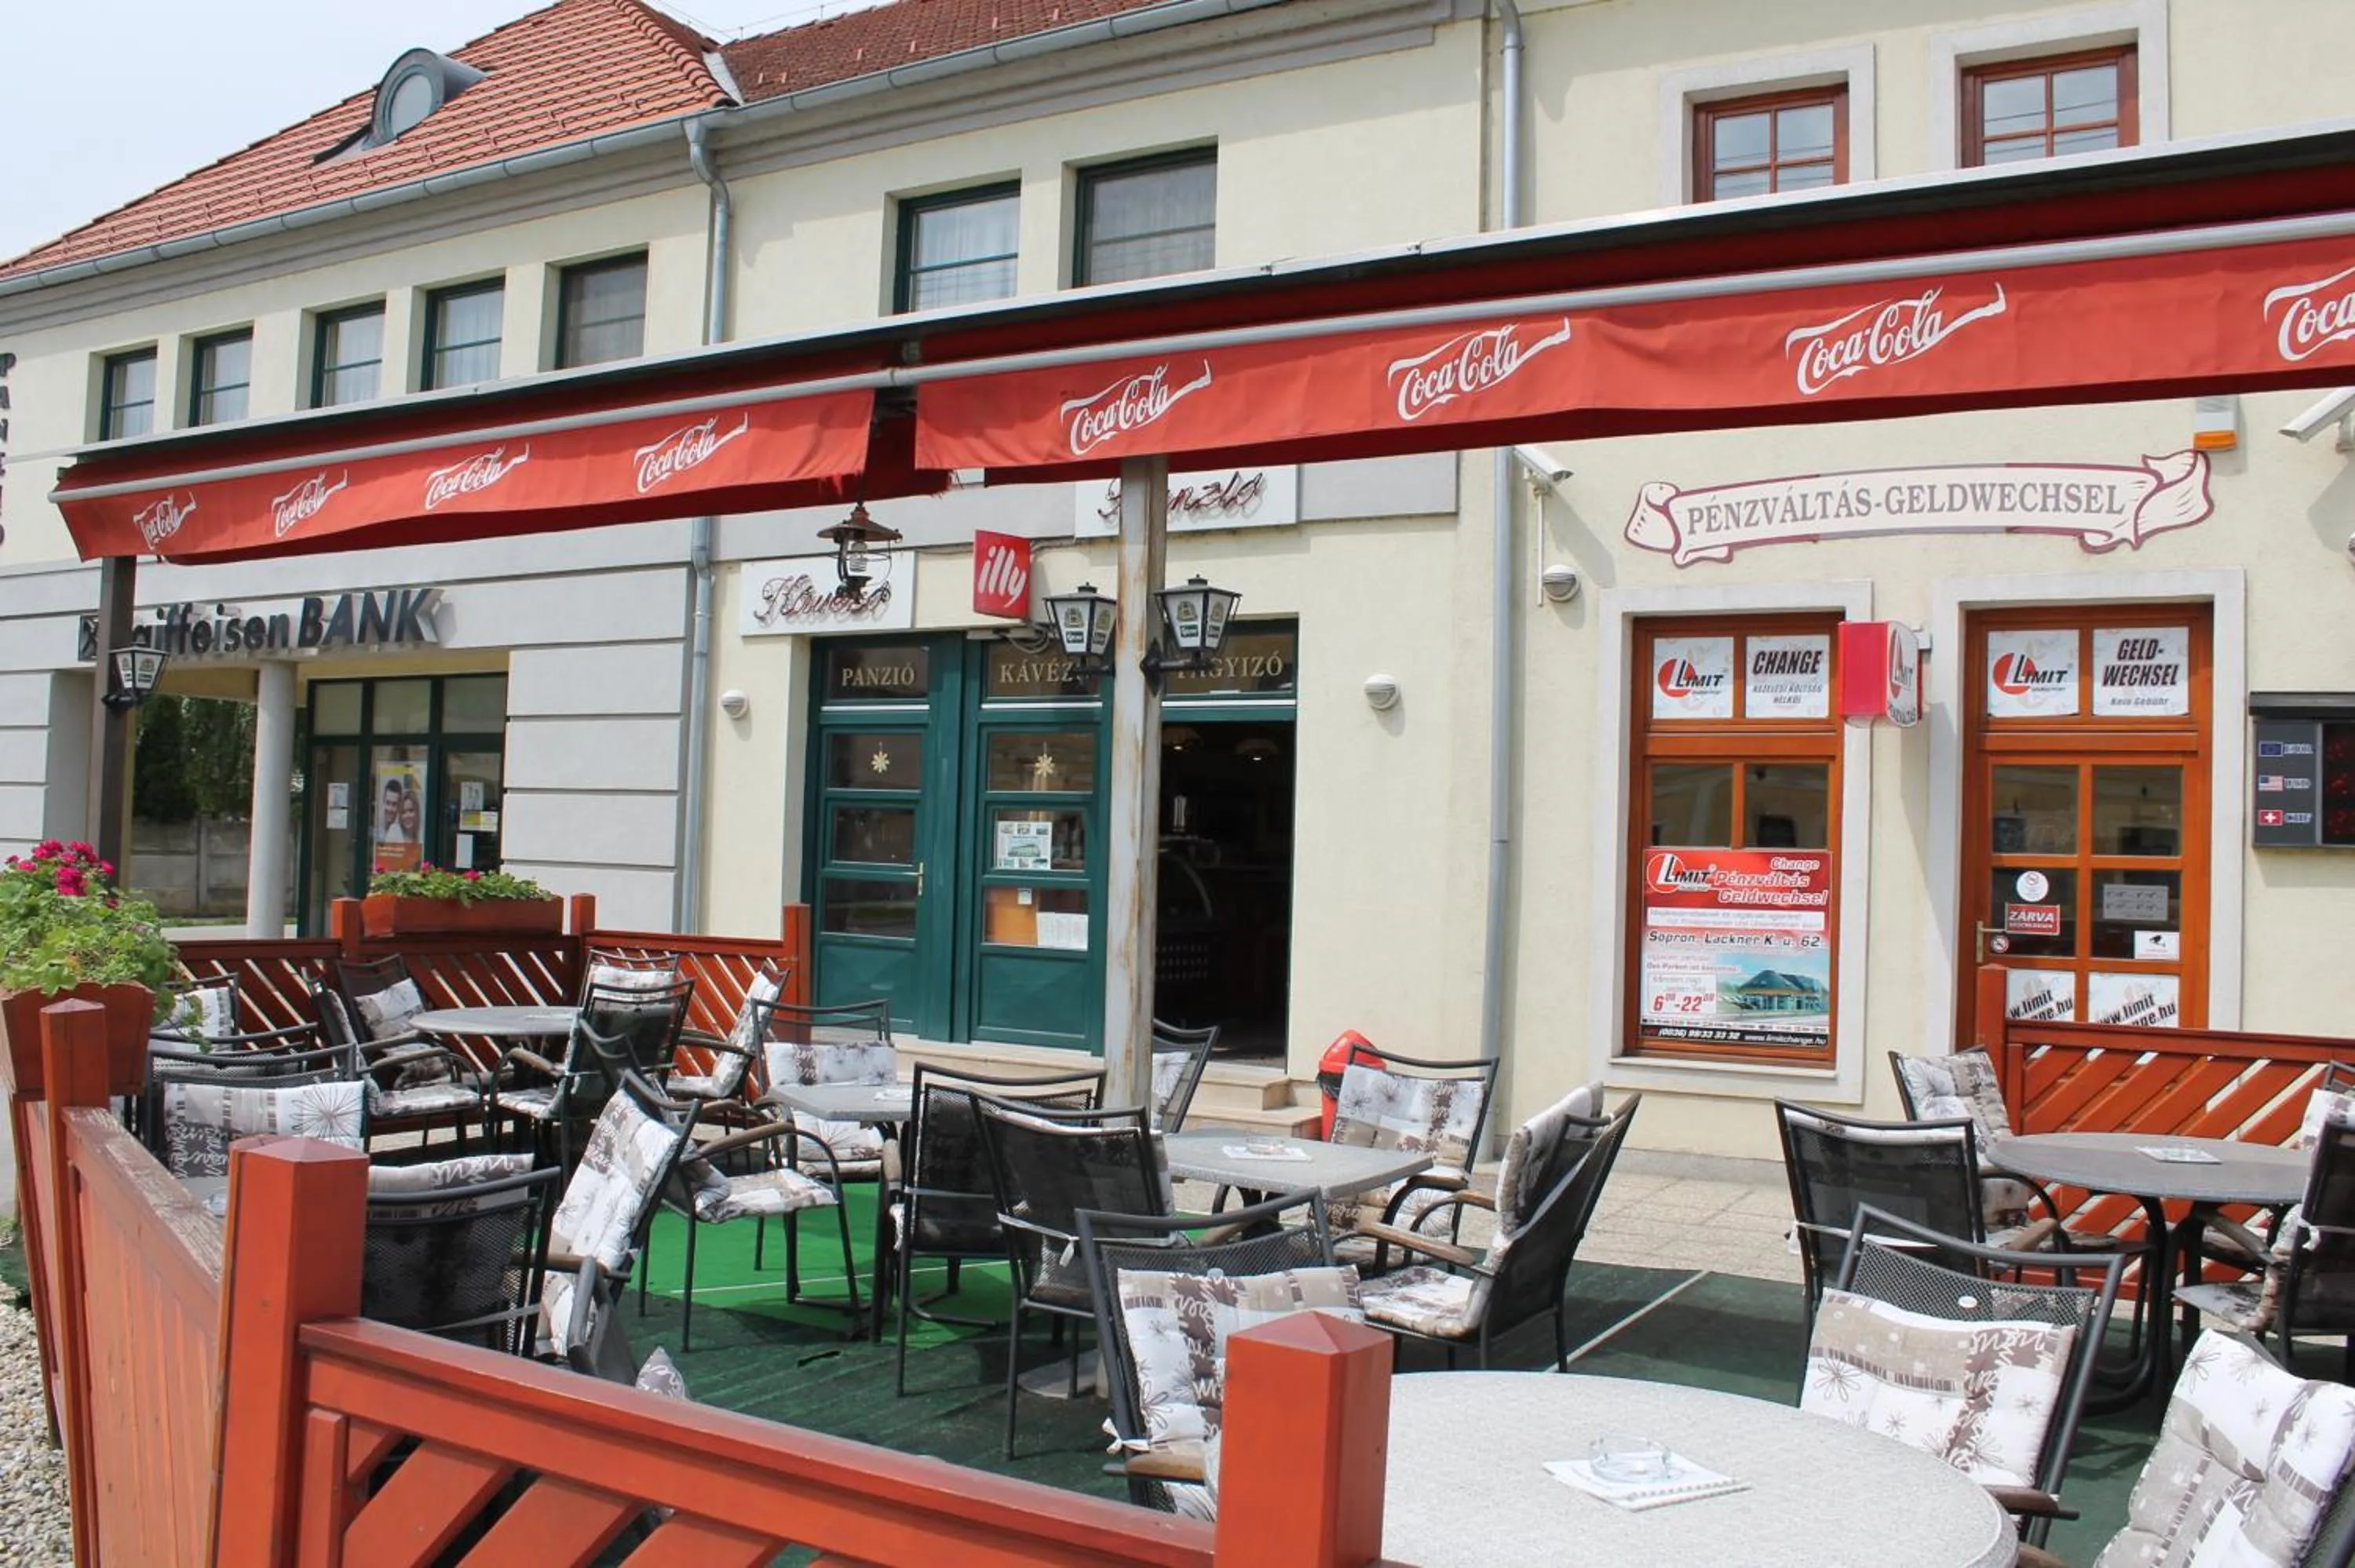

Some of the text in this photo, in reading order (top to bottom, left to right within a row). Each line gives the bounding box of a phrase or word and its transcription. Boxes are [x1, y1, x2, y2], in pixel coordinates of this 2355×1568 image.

[1786, 282, 2006, 396] Coca-Cola
[1386, 315, 1571, 421] Coca-Cola
[1060, 359, 1213, 456] Coca-Cola
[978, 545, 1027, 608] illy
[298, 587, 433, 648] BANK
[999, 658, 1090, 684] KÁVÉZ
[1753, 650, 1823, 676] CHANGE
[2117, 639, 2163, 660] GELD-
[841, 662, 915, 687] PANZIÓ
[2102, 664, 2180, 686] WECHSEL
